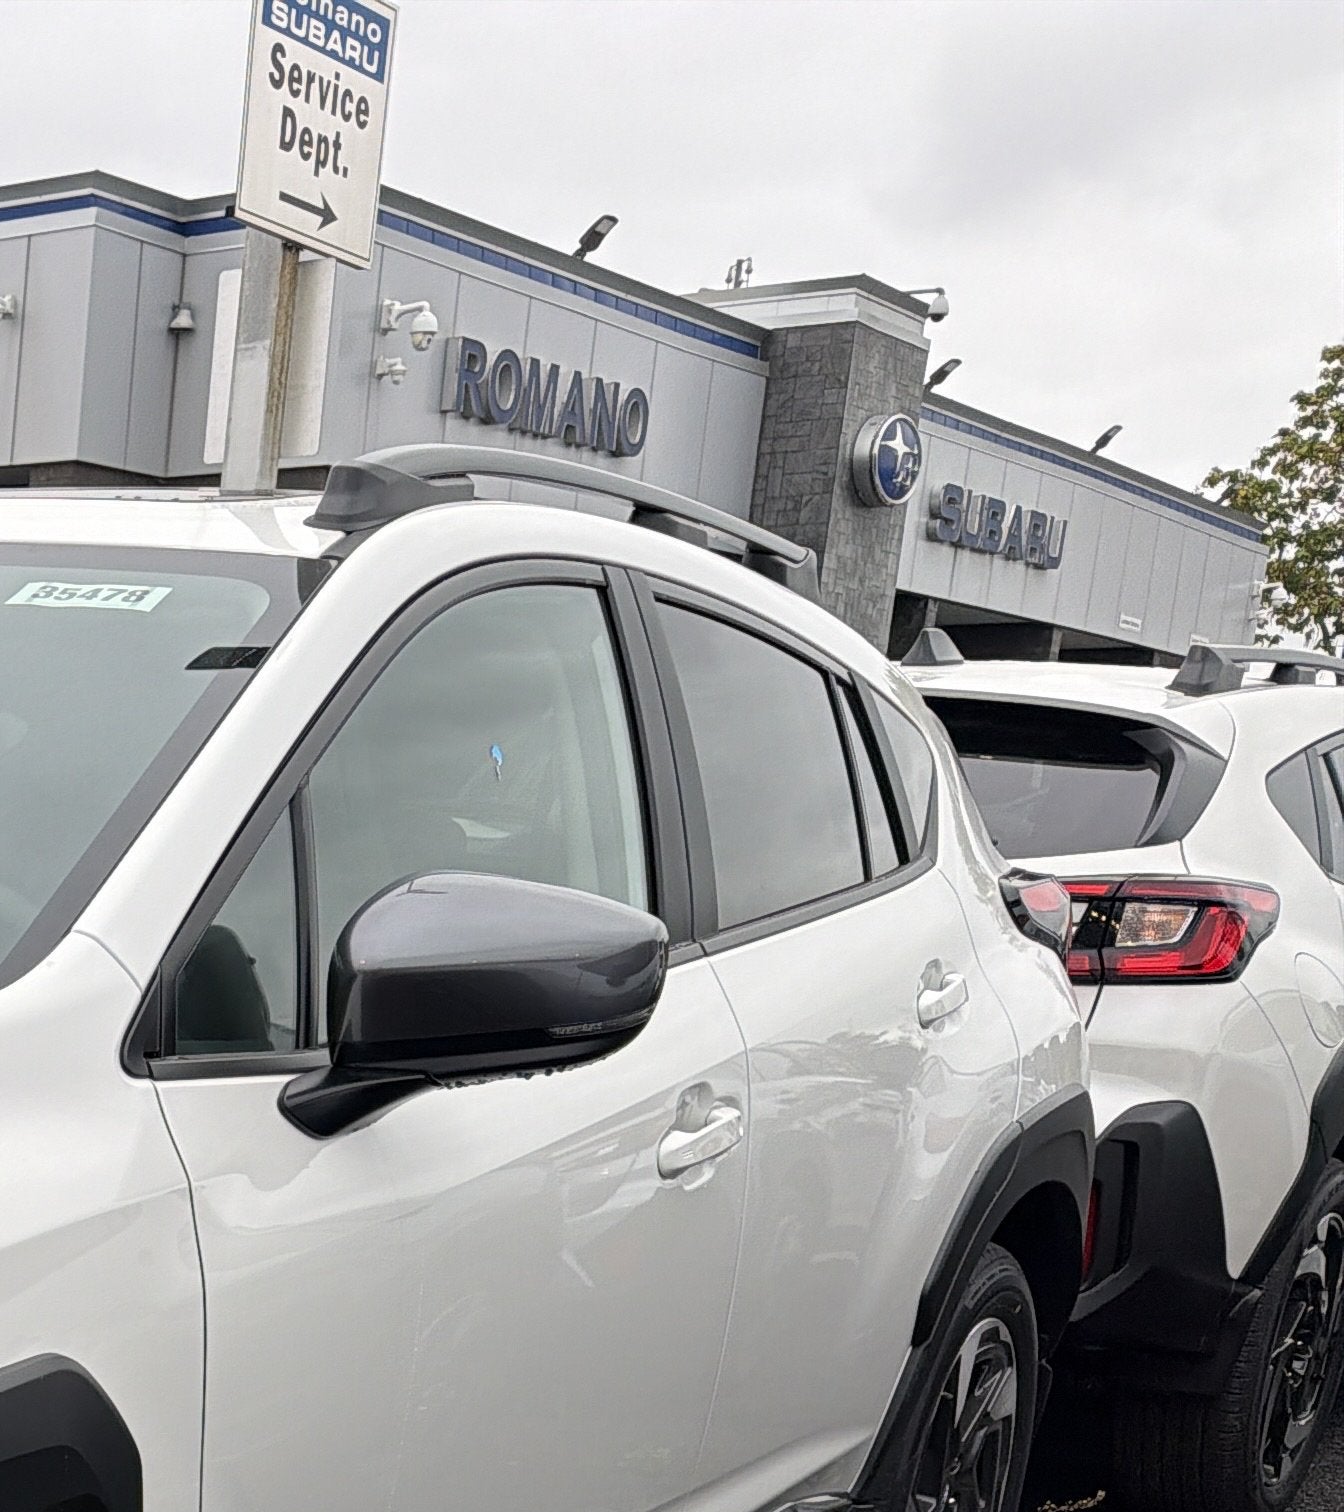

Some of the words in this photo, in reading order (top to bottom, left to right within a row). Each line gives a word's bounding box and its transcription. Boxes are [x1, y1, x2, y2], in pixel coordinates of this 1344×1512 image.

[270, 0, 380, 74] SUBARU
[268, 41, 371, 131] Service
[278, 104, 349, 179] Dept.
[448, 335, 650, 457] ROMANO
[931, 481, 1069, 570] SUBARU
[30, 584, 151, 604] 35478
